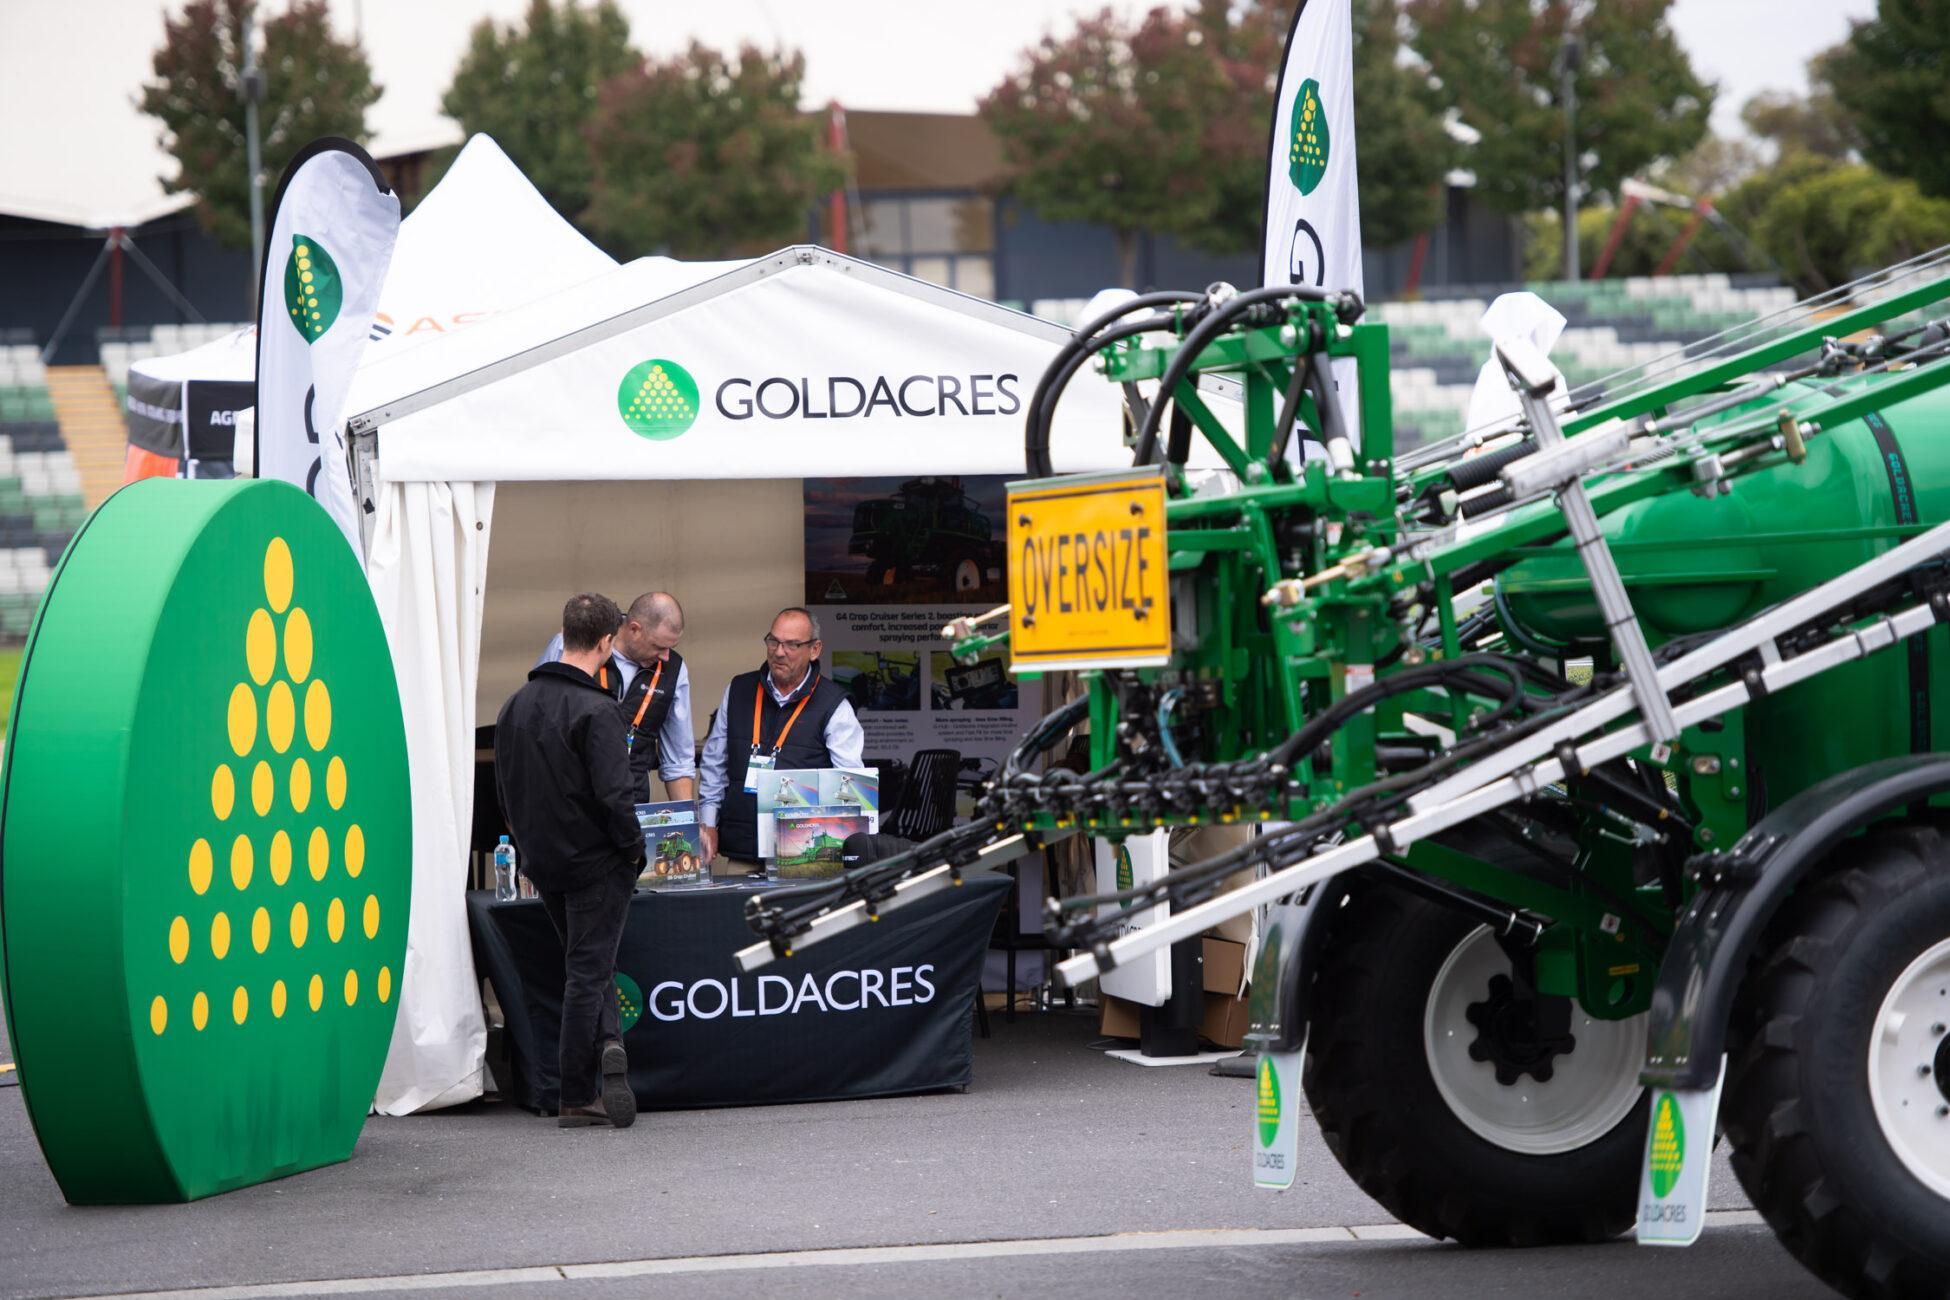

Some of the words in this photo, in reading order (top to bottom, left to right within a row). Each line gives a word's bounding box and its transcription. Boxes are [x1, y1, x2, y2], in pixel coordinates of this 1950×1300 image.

[715, 373, 1021, 420] GOLDACRES
[1022, 528, 1153, 615] OVERSIZE
[836, 612, 848, 621] G4
[849, 612, 869, 623] Crop
[870, 612, 899, 621] Cruiser
[900, 612, 926, 621] Series
[887, 622, 928, 631] increased
[879, 633, 915, 643] spraying
[916, 633, 943, 643] perfor
[649, 964, 936, 1022] GOLDACRES
